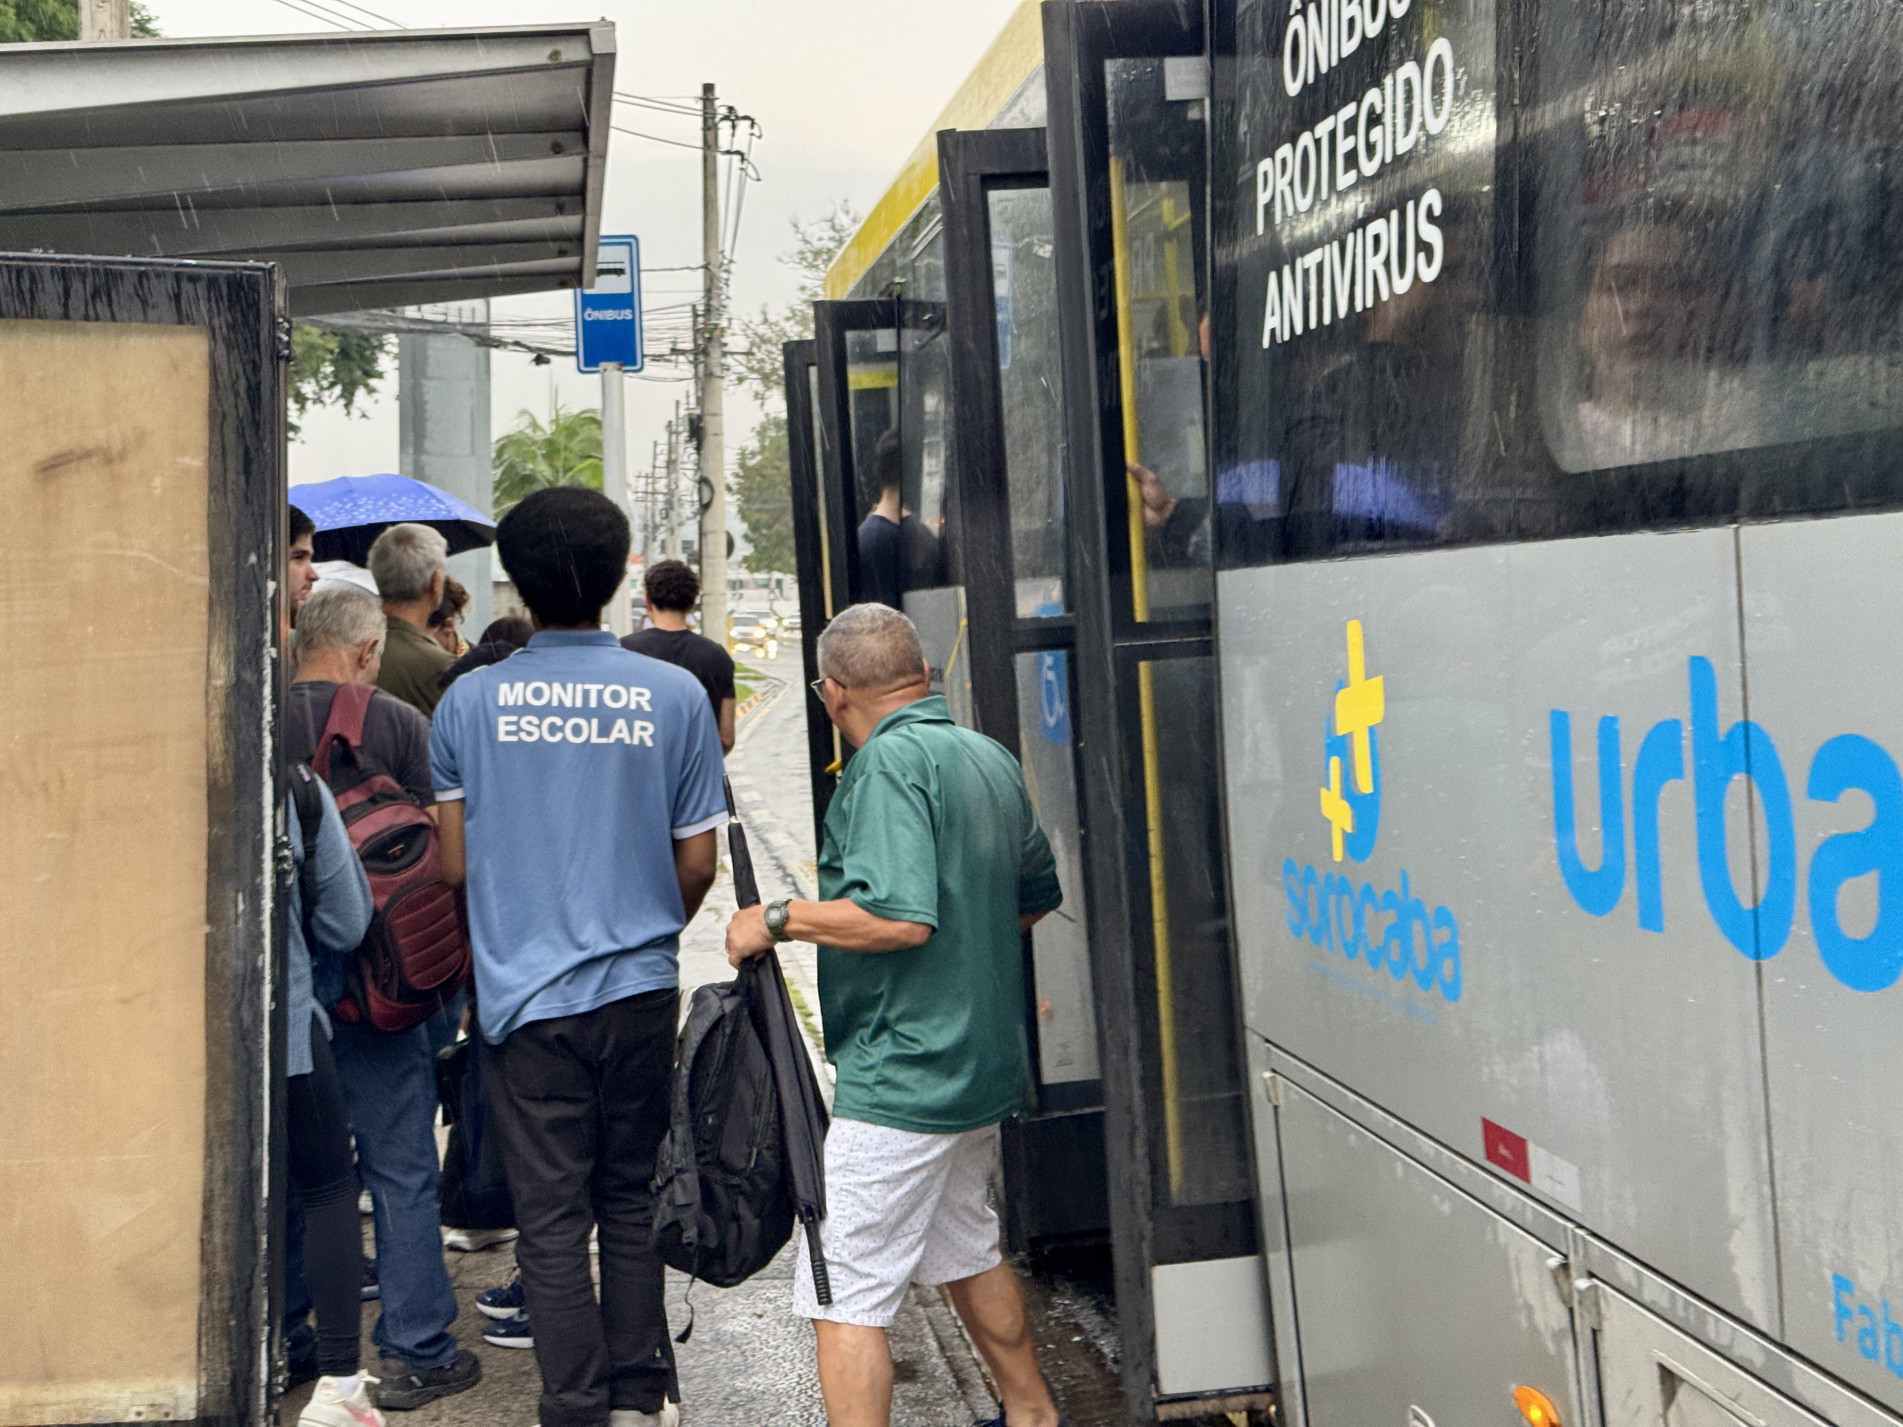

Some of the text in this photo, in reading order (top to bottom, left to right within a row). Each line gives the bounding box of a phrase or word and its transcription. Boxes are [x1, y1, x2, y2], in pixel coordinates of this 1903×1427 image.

[1283, 0, 1410, 97] ÔNIBU
[1257, 37, 1455, 236] PROTEGIDO
[583, 307, 633, 321] ÔNIBUS
[497, 715, 655, 747] ESCOLAR
[498, 681, 653, 712] MONITOR
[1550, 655, 1903, 993] urba
[1282, 857, 1463, 1003] sorocaba
